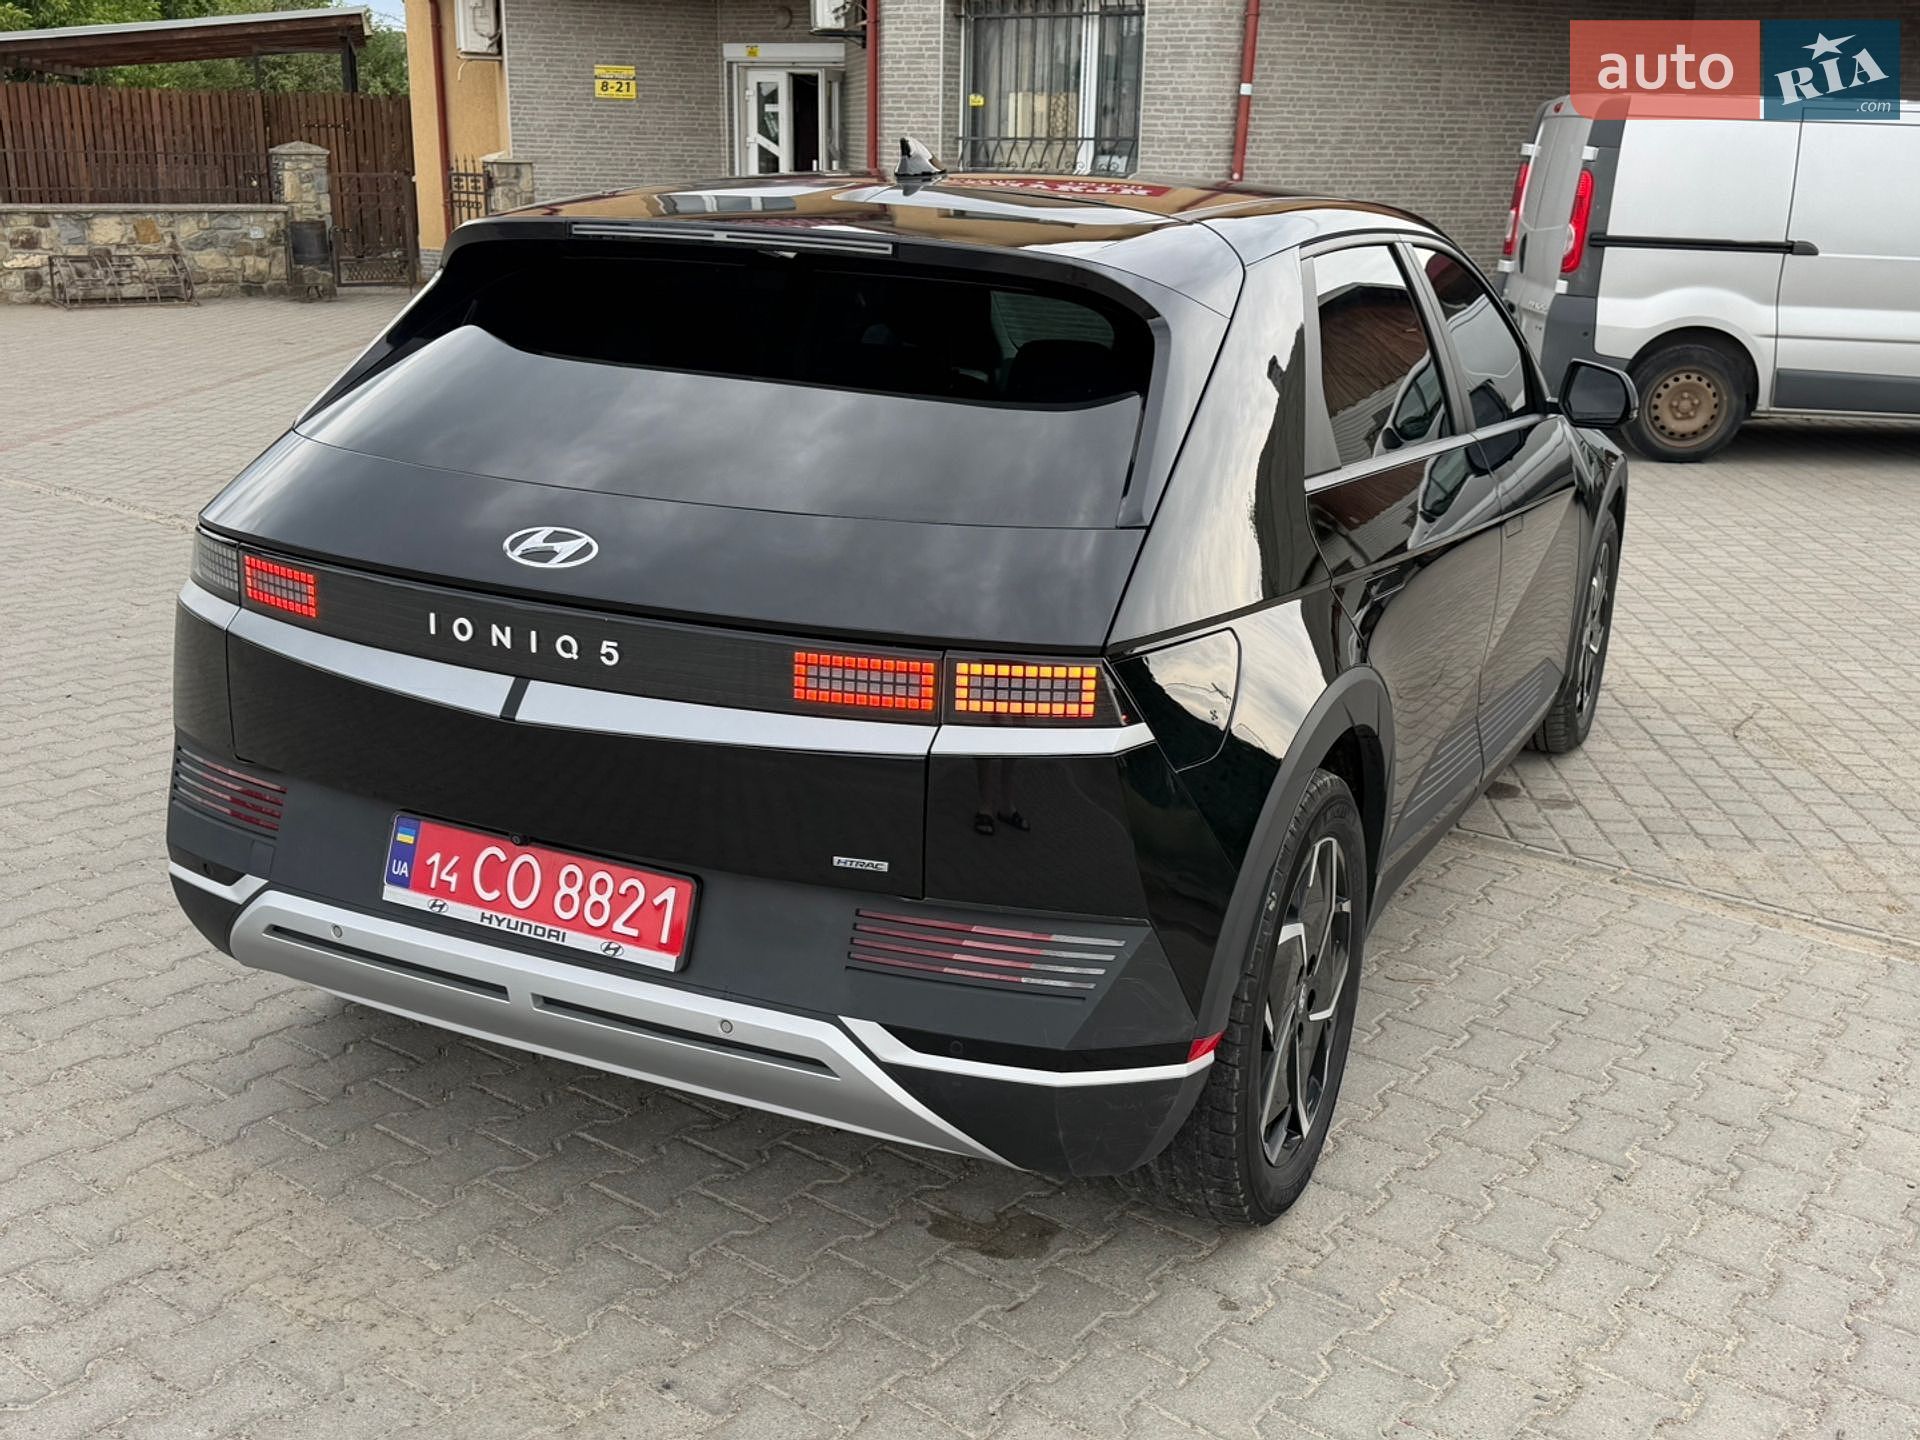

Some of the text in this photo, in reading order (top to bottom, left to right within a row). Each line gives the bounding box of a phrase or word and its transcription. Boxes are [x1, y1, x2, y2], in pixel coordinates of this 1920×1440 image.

[600, 81, 631, 93] 8-21
[429, 612, 620, 666] IONIQ 5
[391, 859, 409, 878] UA
[836, 858, 884, 870] HTRAC
[425, 846, 677, 944] 14 CO 8821
[479, 911, 567, 943] HYUNDAI
